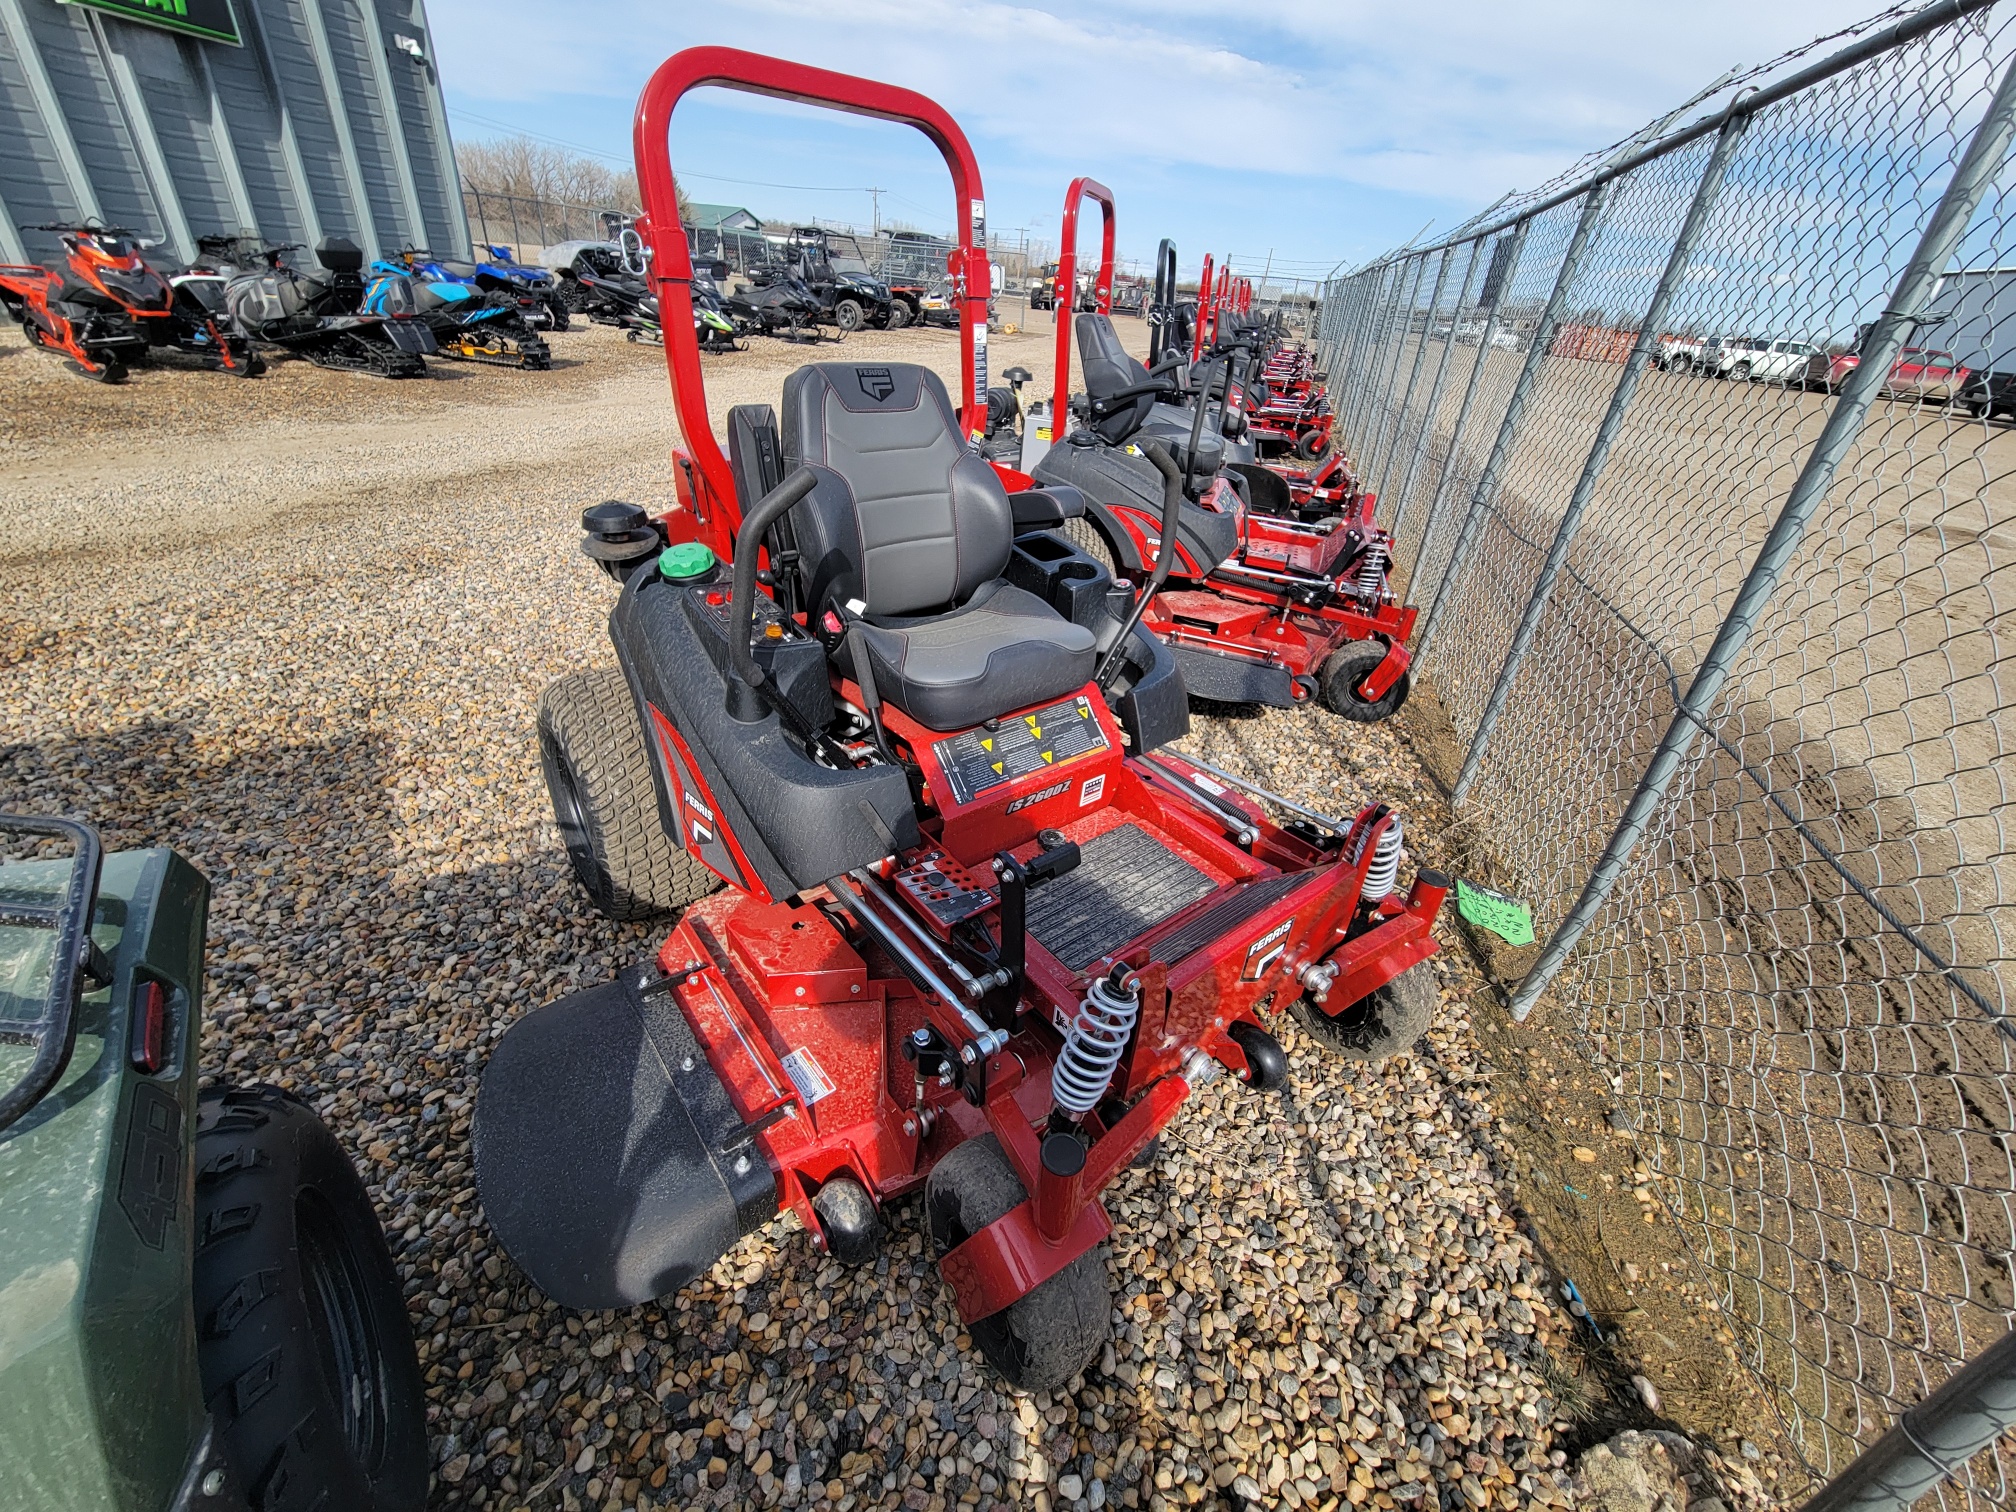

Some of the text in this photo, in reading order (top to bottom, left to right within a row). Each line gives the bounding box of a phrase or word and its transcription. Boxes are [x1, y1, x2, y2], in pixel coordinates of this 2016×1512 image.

[685, 791, 713, 822] FERRIS
[1006, 799, 1024, 814] IS
[1024, 779, 1072, 807] 2600Z
[1249, 918, 1294, 956] FERRIS
